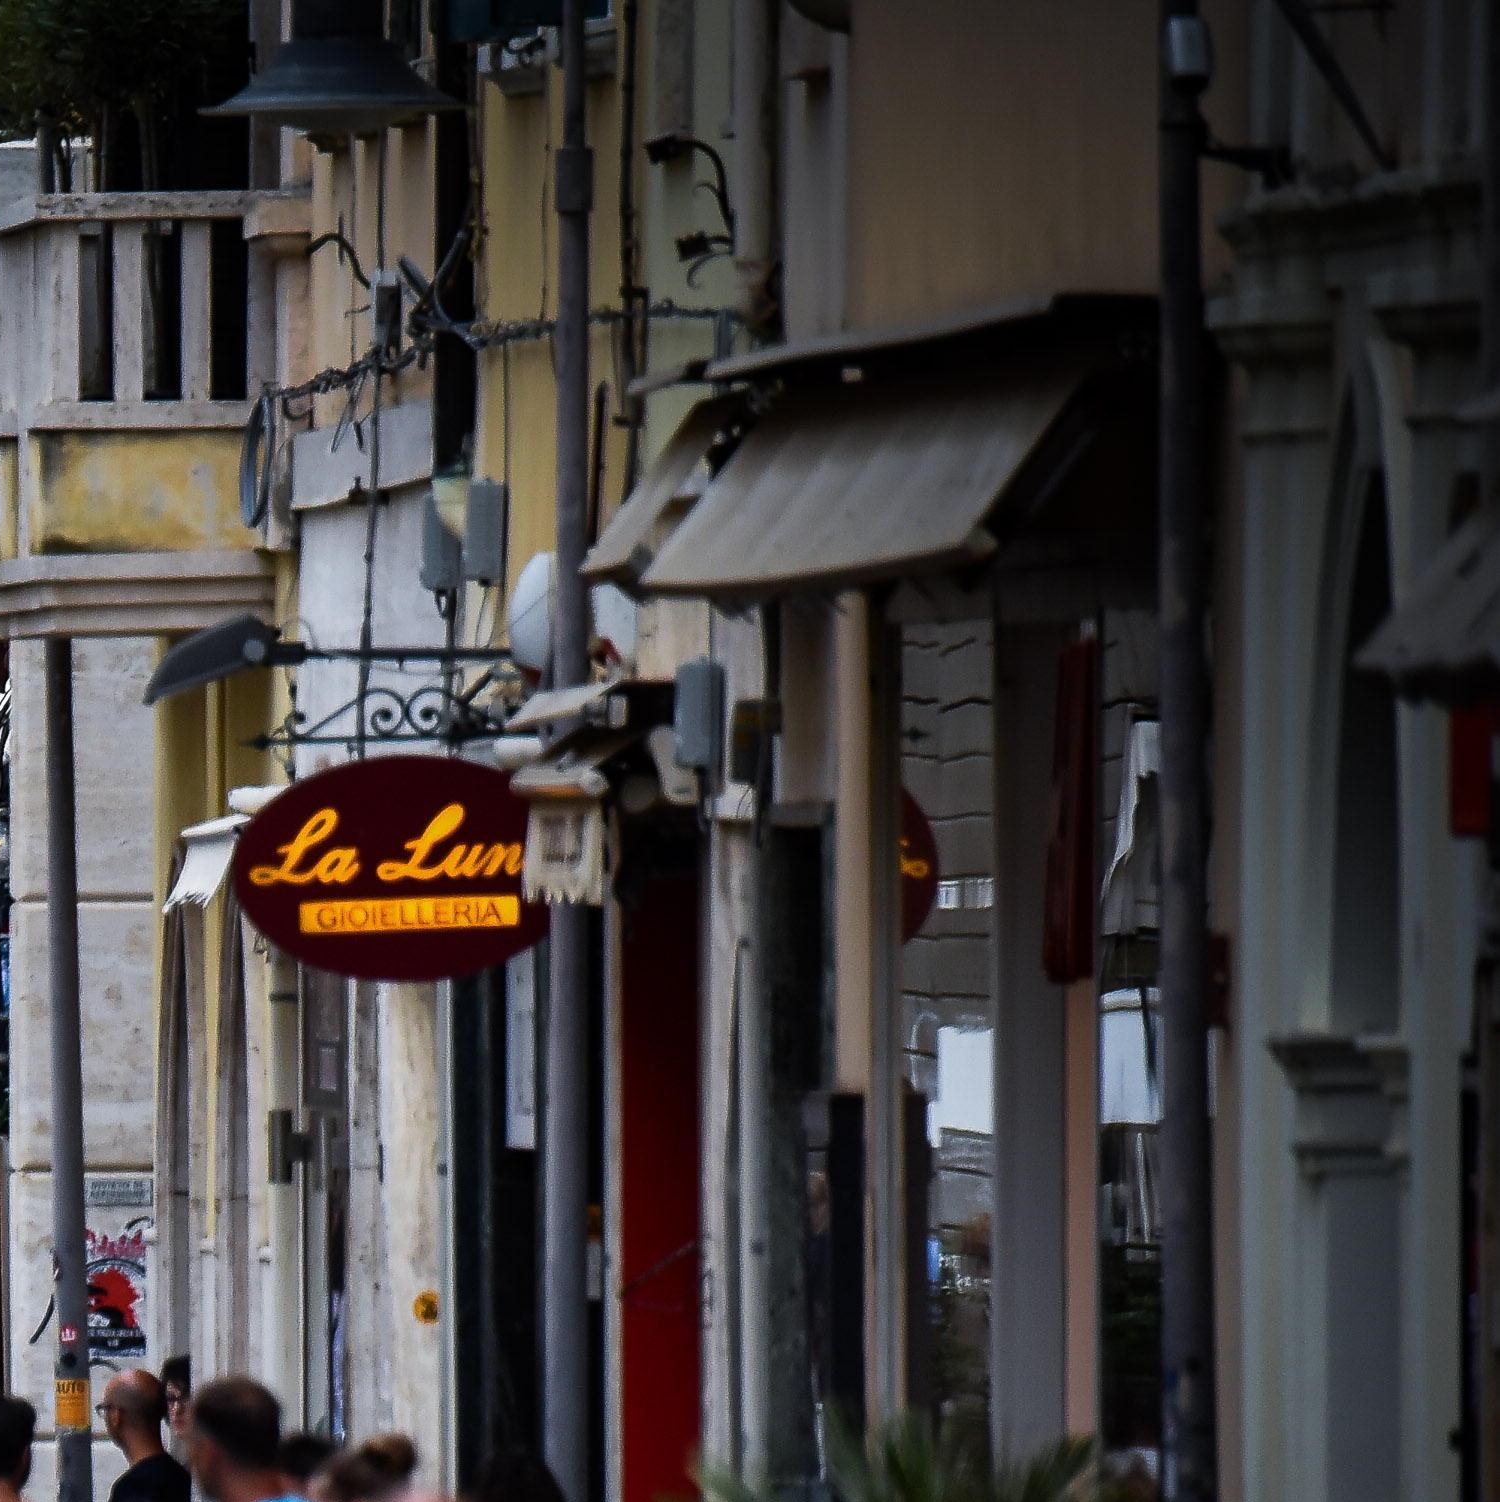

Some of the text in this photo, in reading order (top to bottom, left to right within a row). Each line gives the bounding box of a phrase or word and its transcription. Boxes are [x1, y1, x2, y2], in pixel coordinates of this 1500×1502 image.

[249, 801, 523, 885] La Lun
[315, 899, 504, 931] GIOIELLERIA
